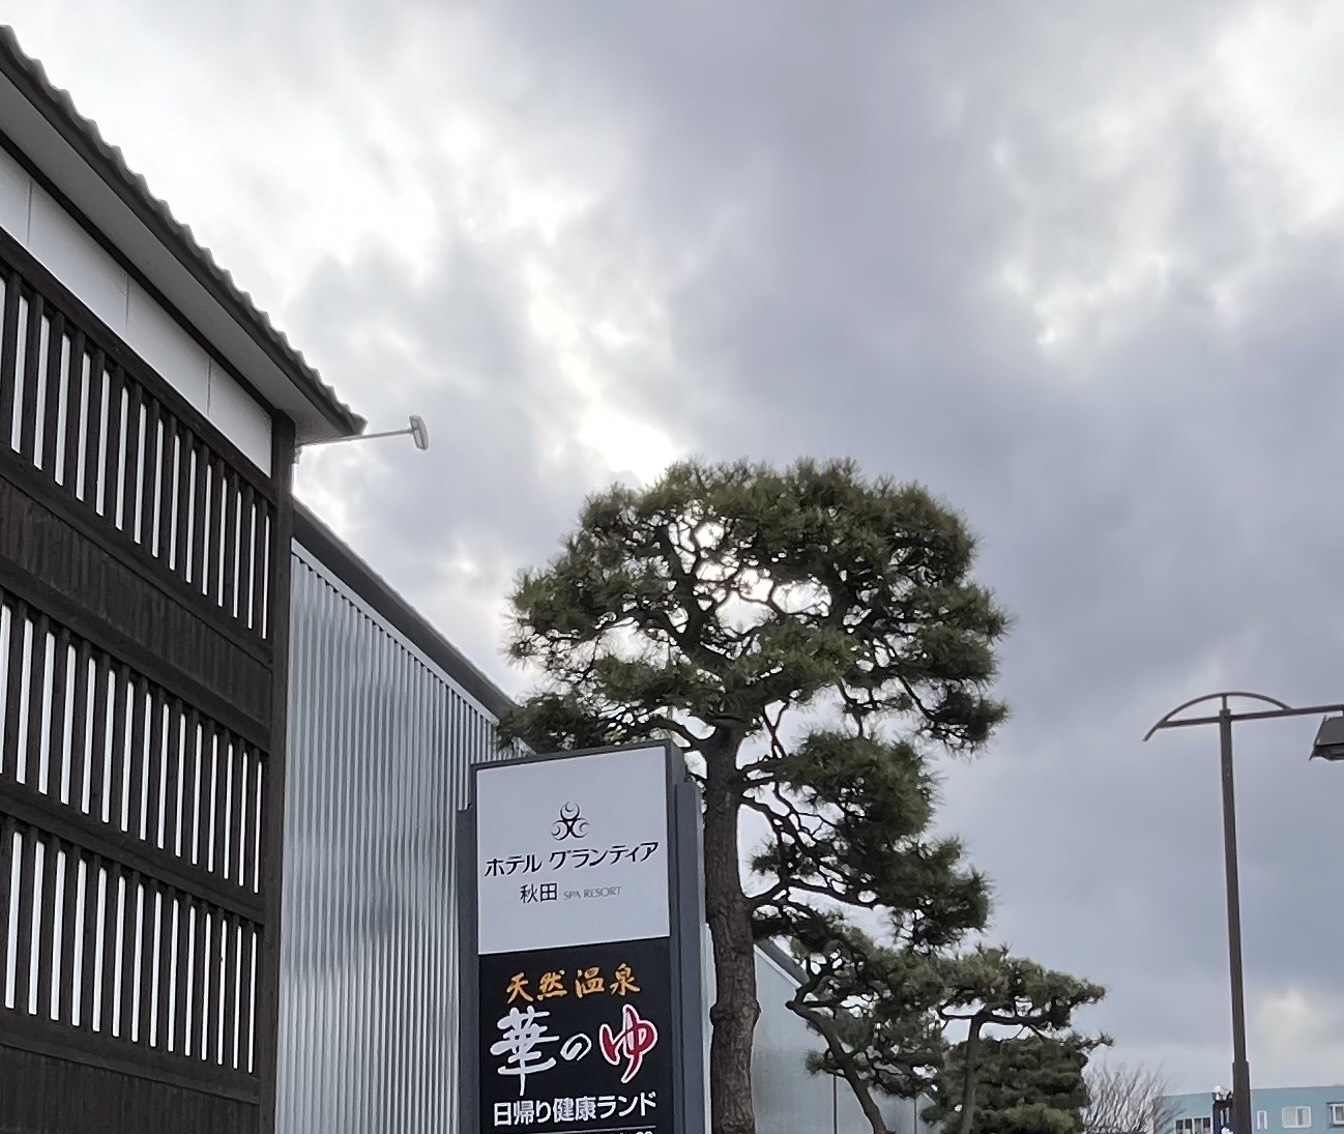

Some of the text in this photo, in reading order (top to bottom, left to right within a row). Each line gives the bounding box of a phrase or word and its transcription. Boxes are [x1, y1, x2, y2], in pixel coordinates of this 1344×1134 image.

[484, 841, 659, 877] ホテル グランティア
[520, 883, 622, 904] 秋田 SPA RESORT
[507, 963, 641, 1004] 天然温泉
[490, 1003, 658, 1096] 華のゆ
[493, 1091, 657, 1127] 日帰り健康ランド
